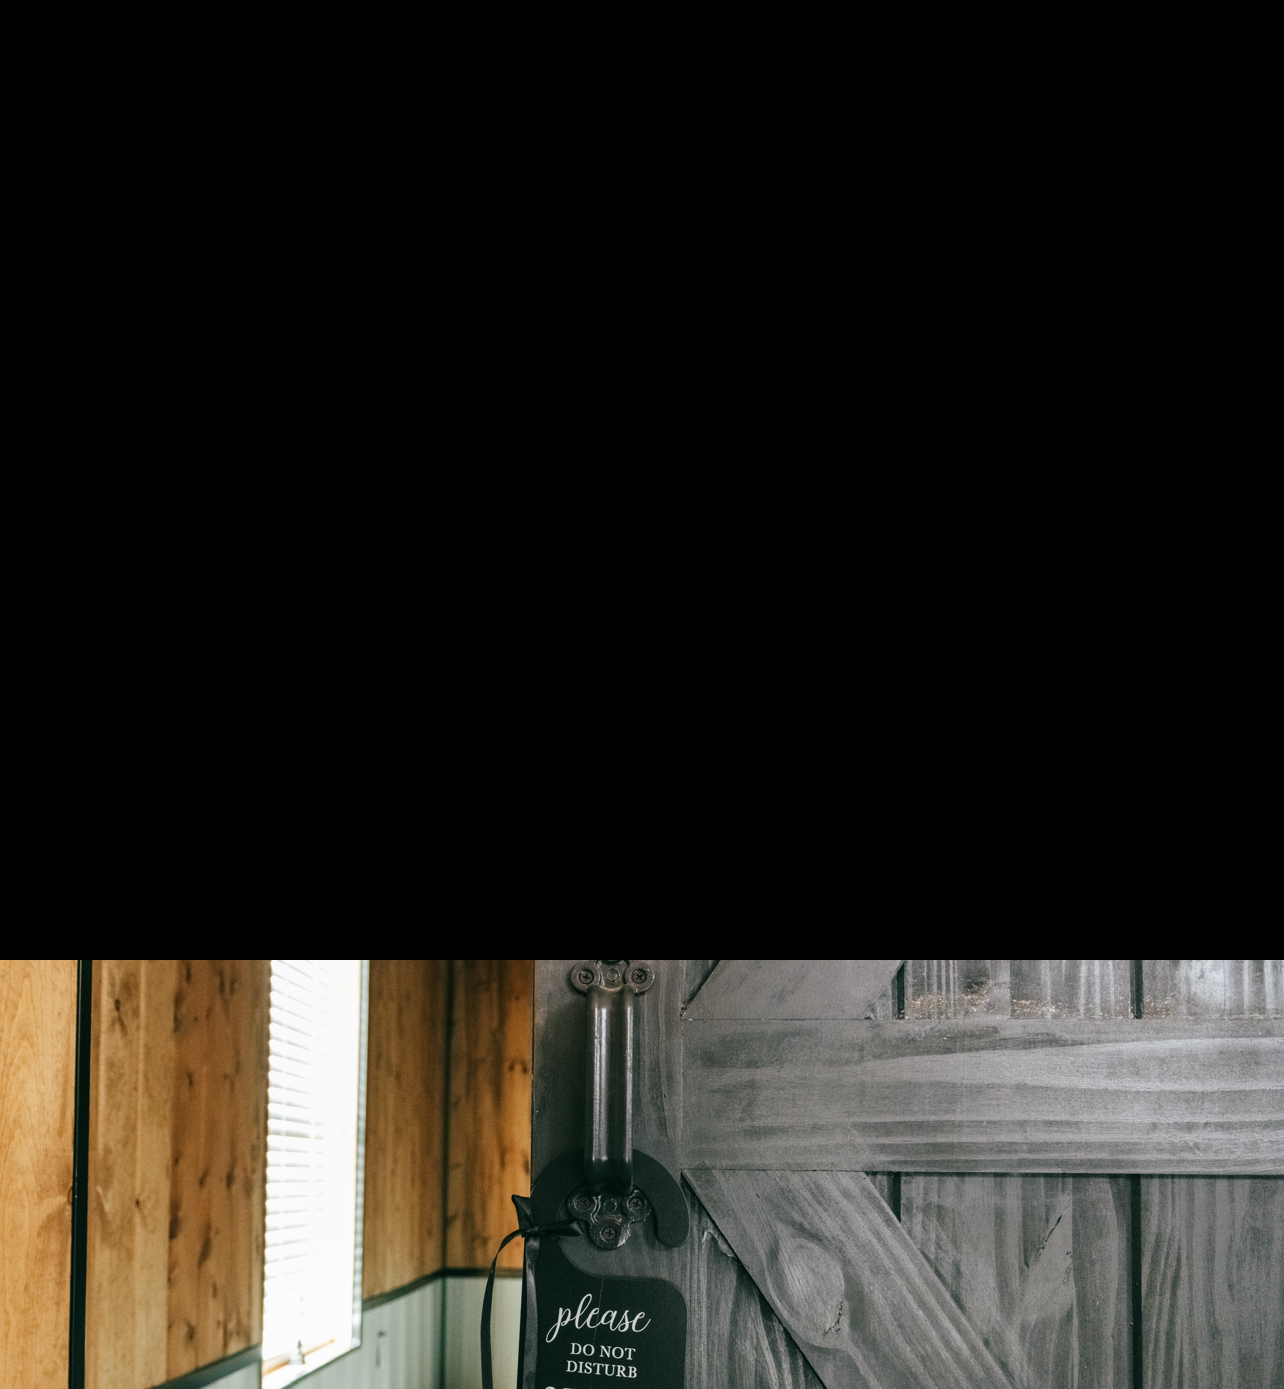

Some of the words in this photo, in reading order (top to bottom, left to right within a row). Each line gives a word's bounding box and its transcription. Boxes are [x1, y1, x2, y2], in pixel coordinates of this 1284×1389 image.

[545, 1293, 651, 1343] please
[570, 1342, 595, 1357] DO
[599, 1345, 636, 1360] NOT
[566, 1360, 637, 1378] DISTURB
